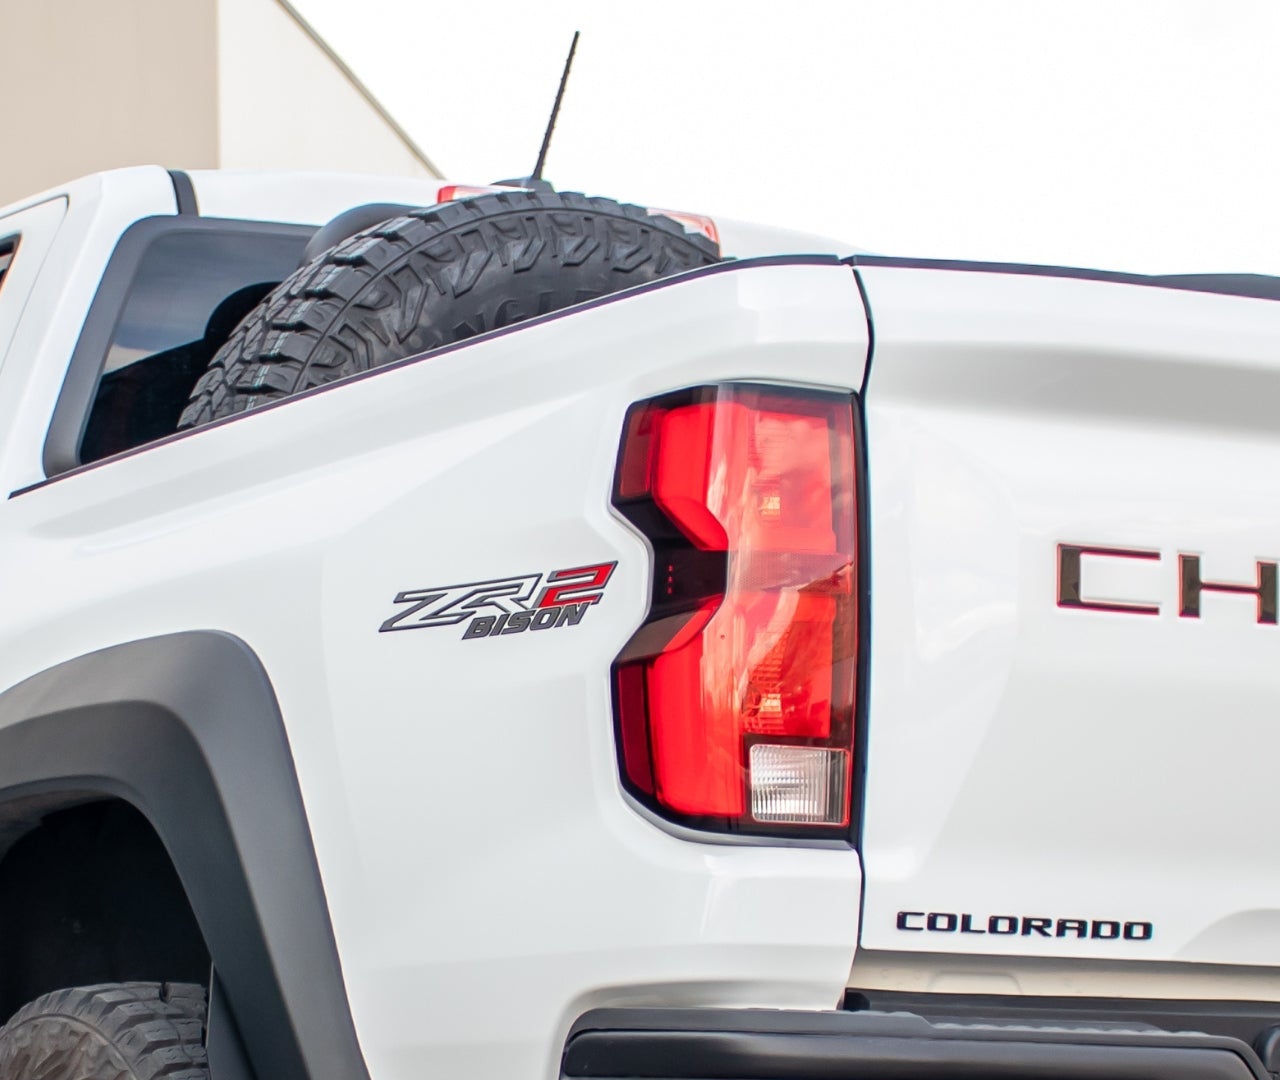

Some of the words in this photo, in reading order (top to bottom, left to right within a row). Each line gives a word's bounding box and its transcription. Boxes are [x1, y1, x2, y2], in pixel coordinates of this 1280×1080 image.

[379, 560, 618, 632] ZR2
[461, 601, 594, 640] BISON
[896, 911, 1153, 940] COLORADO
